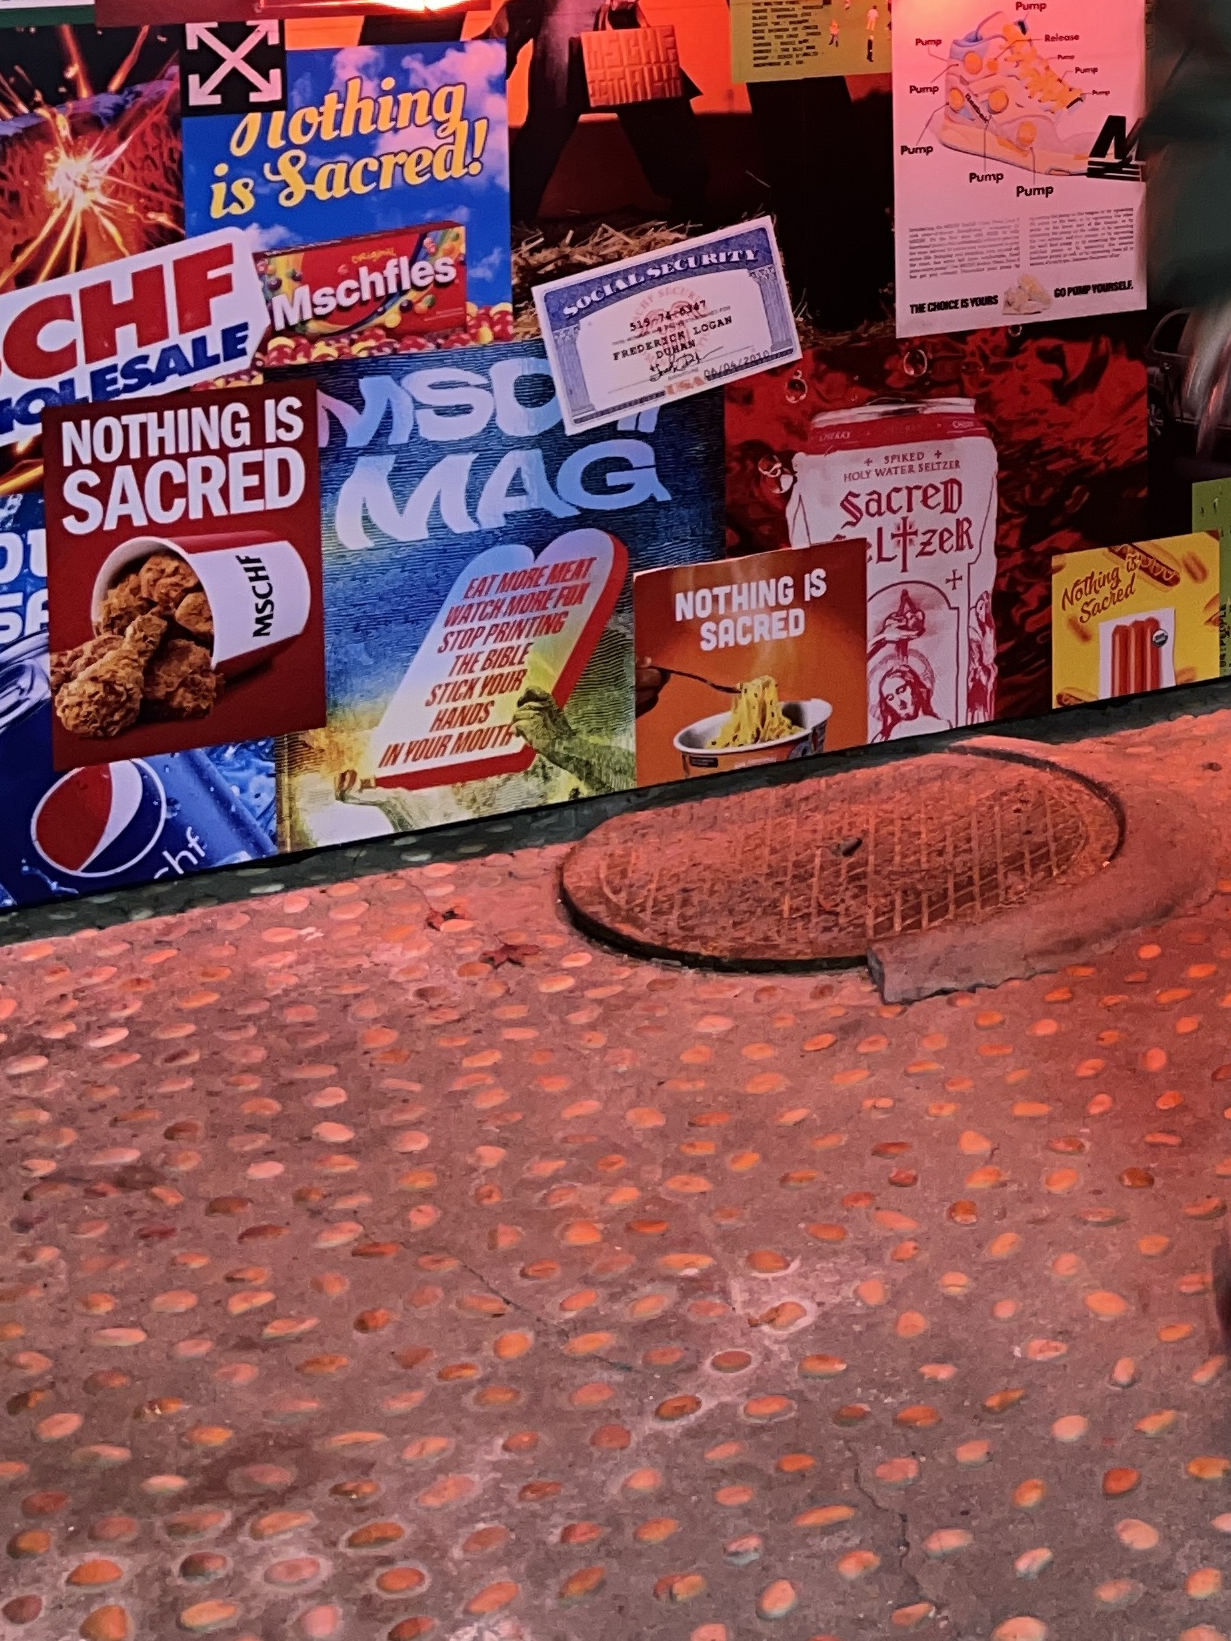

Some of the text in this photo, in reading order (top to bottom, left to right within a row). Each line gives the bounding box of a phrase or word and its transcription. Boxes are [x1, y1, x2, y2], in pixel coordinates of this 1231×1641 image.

[1015, 1, 1048, 14] Pump
[915, 37, 942, 49] Pump
[1044, 33, 1081, 43] Release
[909, 84, 940, 96] Pump
[1074, 65, 1099, 76] Pump
[209, 116, 489, 219] is Sacred!
[900, 144, 935, 157] Pump
[969, 171, 1004, 185] Pump
[1016, 185, 1055, 199] Pump
[271, 254, 457, 332] Mschfles
[562, 271, 645, 320] SOCIAL
[646, 248, 761, 280] SECURITY
[909, 303, 927, 315] THE
[960, 298, 969, 310] IS
[970, 294, 999, 308] YOURS
[612, 330, 686, 361] FREDERICK
[693, 315, 733, 336] LOGAN
[61, 395, 305, 468] NOTHING IS
[843, 459, 962, 483] HOLY WATER SELTZER
[883, 450, 926, 465] SPIKED
[61, 445, 306, 536] SACRED
[334, 439, 673, 551] MAG
[235, 553, 275, 638] MSCHF
[463, 556, 598, 601] EAT MORE MEAT
[675, 566, 828, 623] NOTHING IS
[1061, 565, 1123, 613] Nothing
[1079, 572, 1136, 624] Sacred
[442, 581, 592, 629] WATCH MORE FOX
[437, 610, 570, 655] STOP PRINTING
[700, 607, 806, 652] SACRED
[447, 641, 535, 678] THE BIBLE
[425, 668, 529, 708] STICK YOUR
[429, 699, 496, 733] HANDS
[377, 742, 403, 769] IN
[402, 733, 454, 763] YOUR
